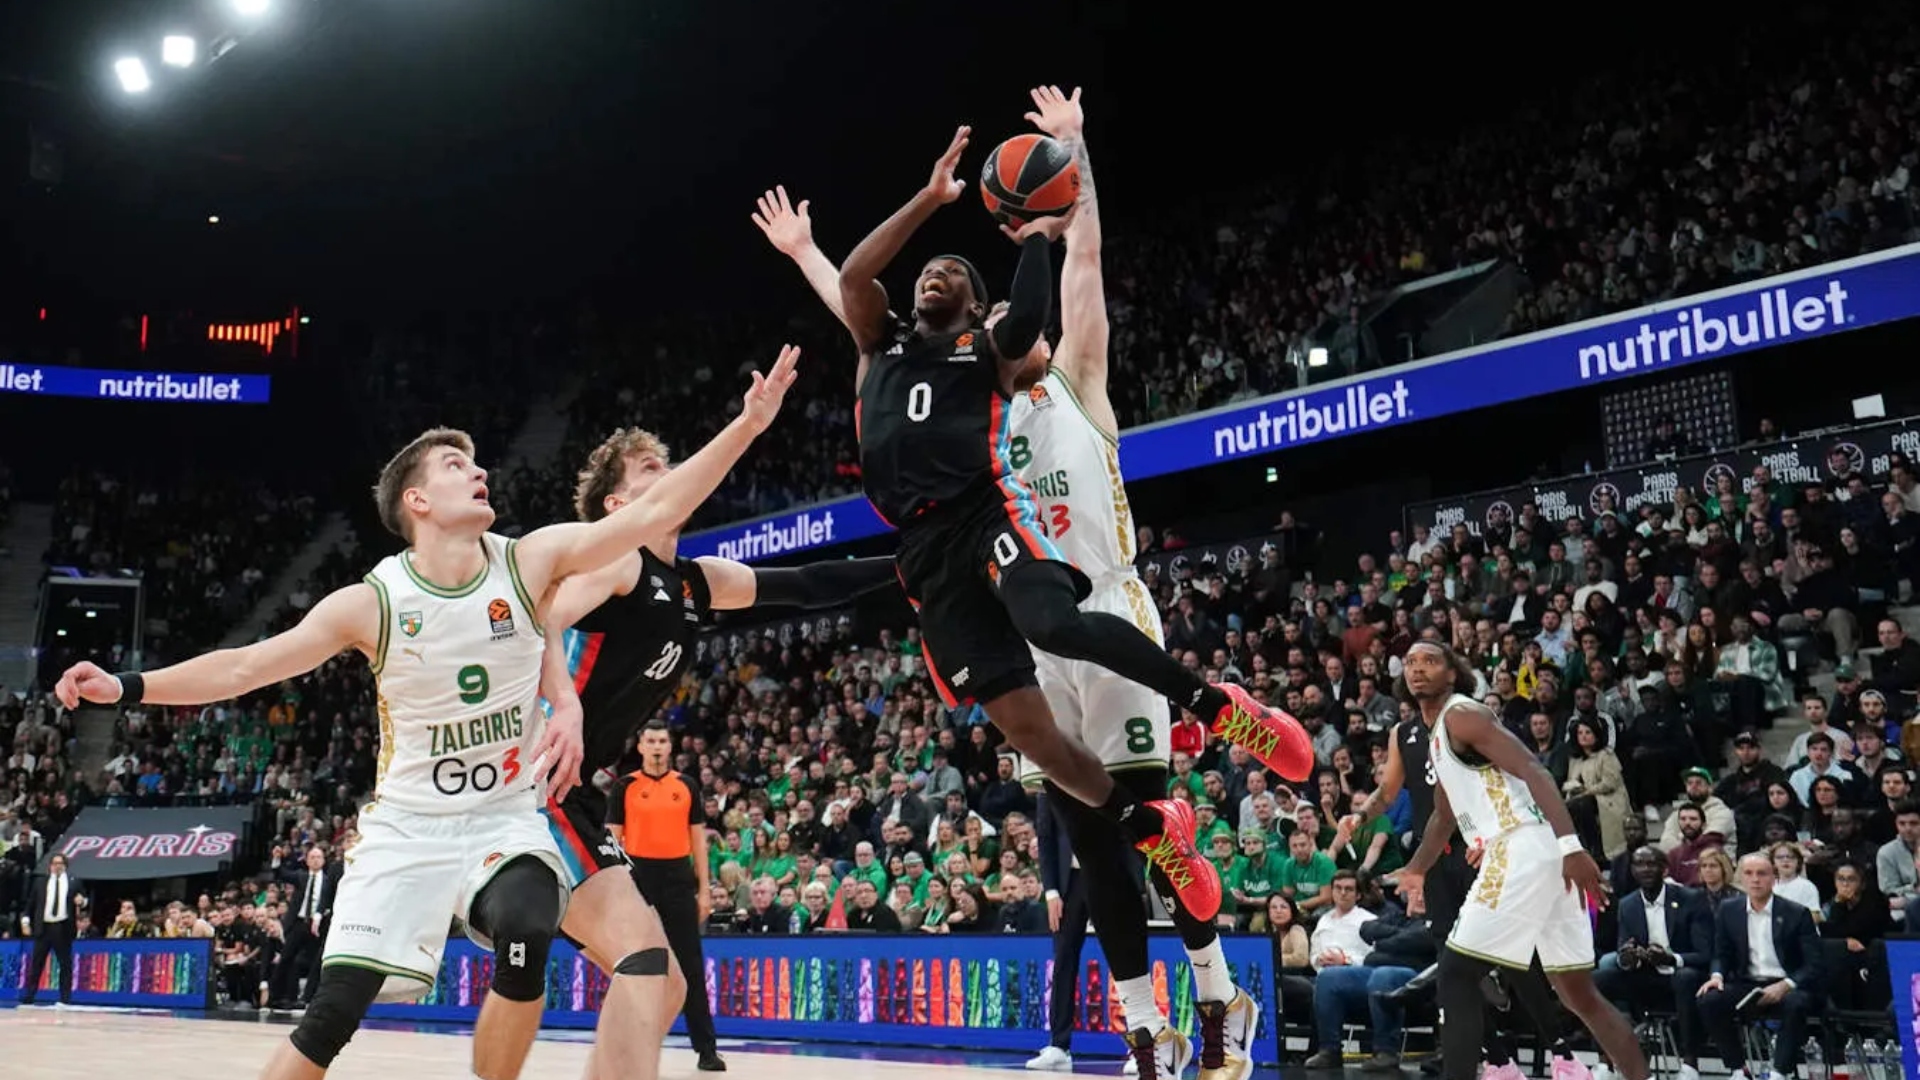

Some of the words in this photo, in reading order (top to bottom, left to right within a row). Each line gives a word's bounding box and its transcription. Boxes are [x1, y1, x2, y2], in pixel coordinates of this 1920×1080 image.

[1579, 280, 1848, 379] nutribullet
[100, 375, 241, 400] nutribullet
[907, 382, 932, 422] 0
[1214, 379, 1409, 457] nutribullet
[1009, 435, 1033, 470] 8
[1643, 472, 1678, 491] PARIS
[718, 511, 834, 560] nutribullet
[993, 532, 1019, 567] 0
[643, 641, 682, 680] 20
[457, 664, 490, 704] 9
[1125, 717, 1155, 754] 8
[62, 829, 237, 859] PARIS
